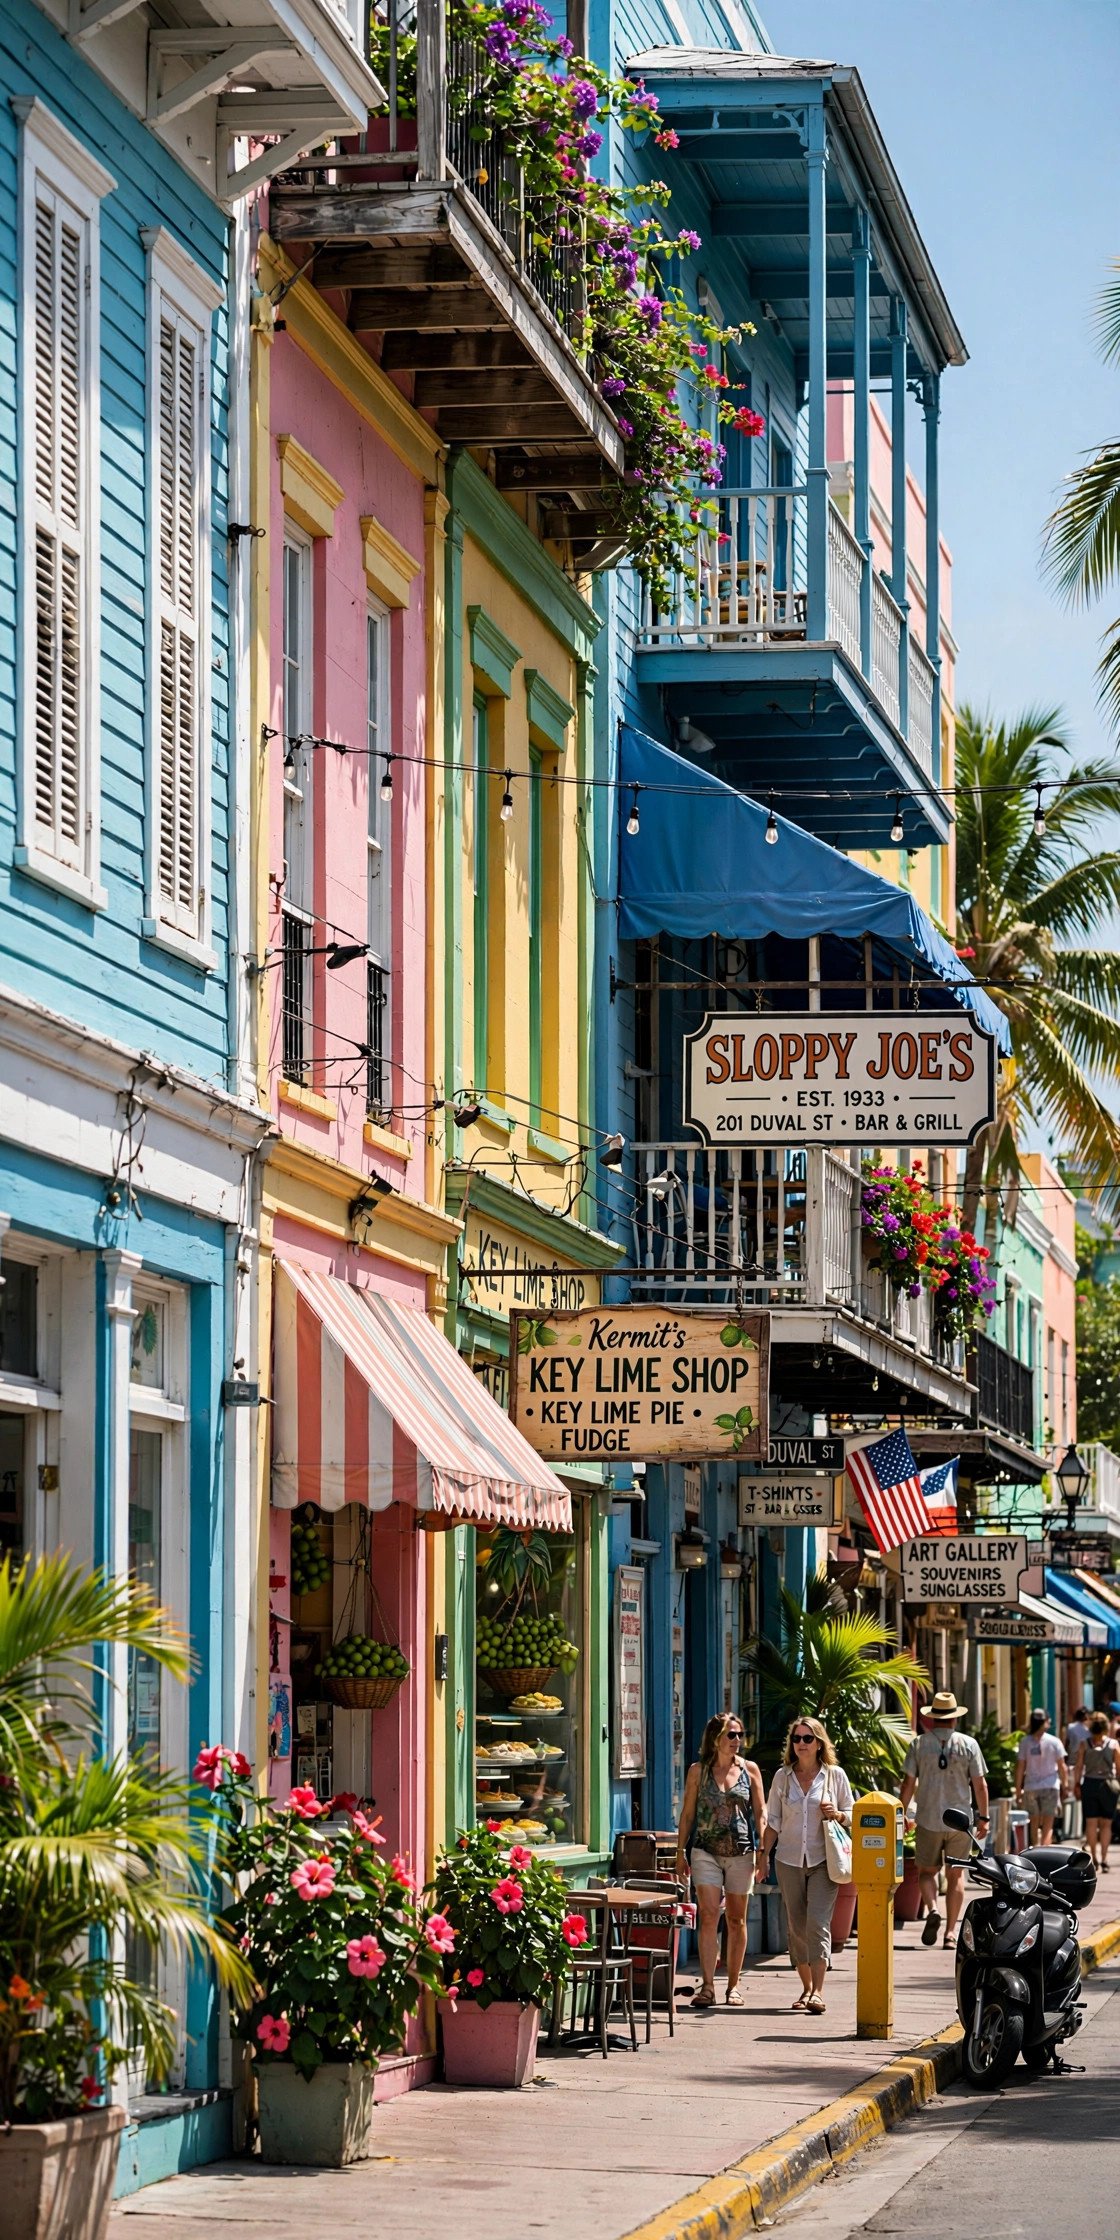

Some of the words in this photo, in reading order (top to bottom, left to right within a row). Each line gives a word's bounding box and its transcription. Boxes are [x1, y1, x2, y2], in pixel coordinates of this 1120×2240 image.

[706, 1033, 857, 1084] SLOPPY
[866, 1029, 974, 1082] JOE'S
[797, 1091, 834, 1107] EST.
[843, 1091, 885, 1107] 1933
[716, 1115, 743, 1131] 201
[751, 1115, 807, 1131] DUVAL
[813, 1115, 833, 1130] ST
[855, 1114, 889, 1130] BAR
[895, 1114, 908, 1130] &
[914, 1114, 963, 1130] GRILL
[478, 1230, 509, 1294] KEY
[514, 1247, 546, 1309] LIME
[588, 1318, 686, 1351] Kermit's
[530, 1357, 585, 1393] KEY
[596, 1357, 662, 1393] LIME
[671, 1357, 749, 1393] SHOP
[541, 1401, 583, 1424] KEY
[591, 1401, 640, 1424] LIME
[651, 1401, 684, 1424] PIE
[561, 1429, 630, 1451] FUDGE
[767, 1442, 817, 1464] DUVAL
[822, 1444, 835, 1459] ST
[909, 1543, 939, 1561] ART
[946, 1542, 1018, 1561] GALLERY
[920, 1567, 1001, 1581] SOUVENIRS
[920, 1583, 1006, 1597] SUNGLASSES
